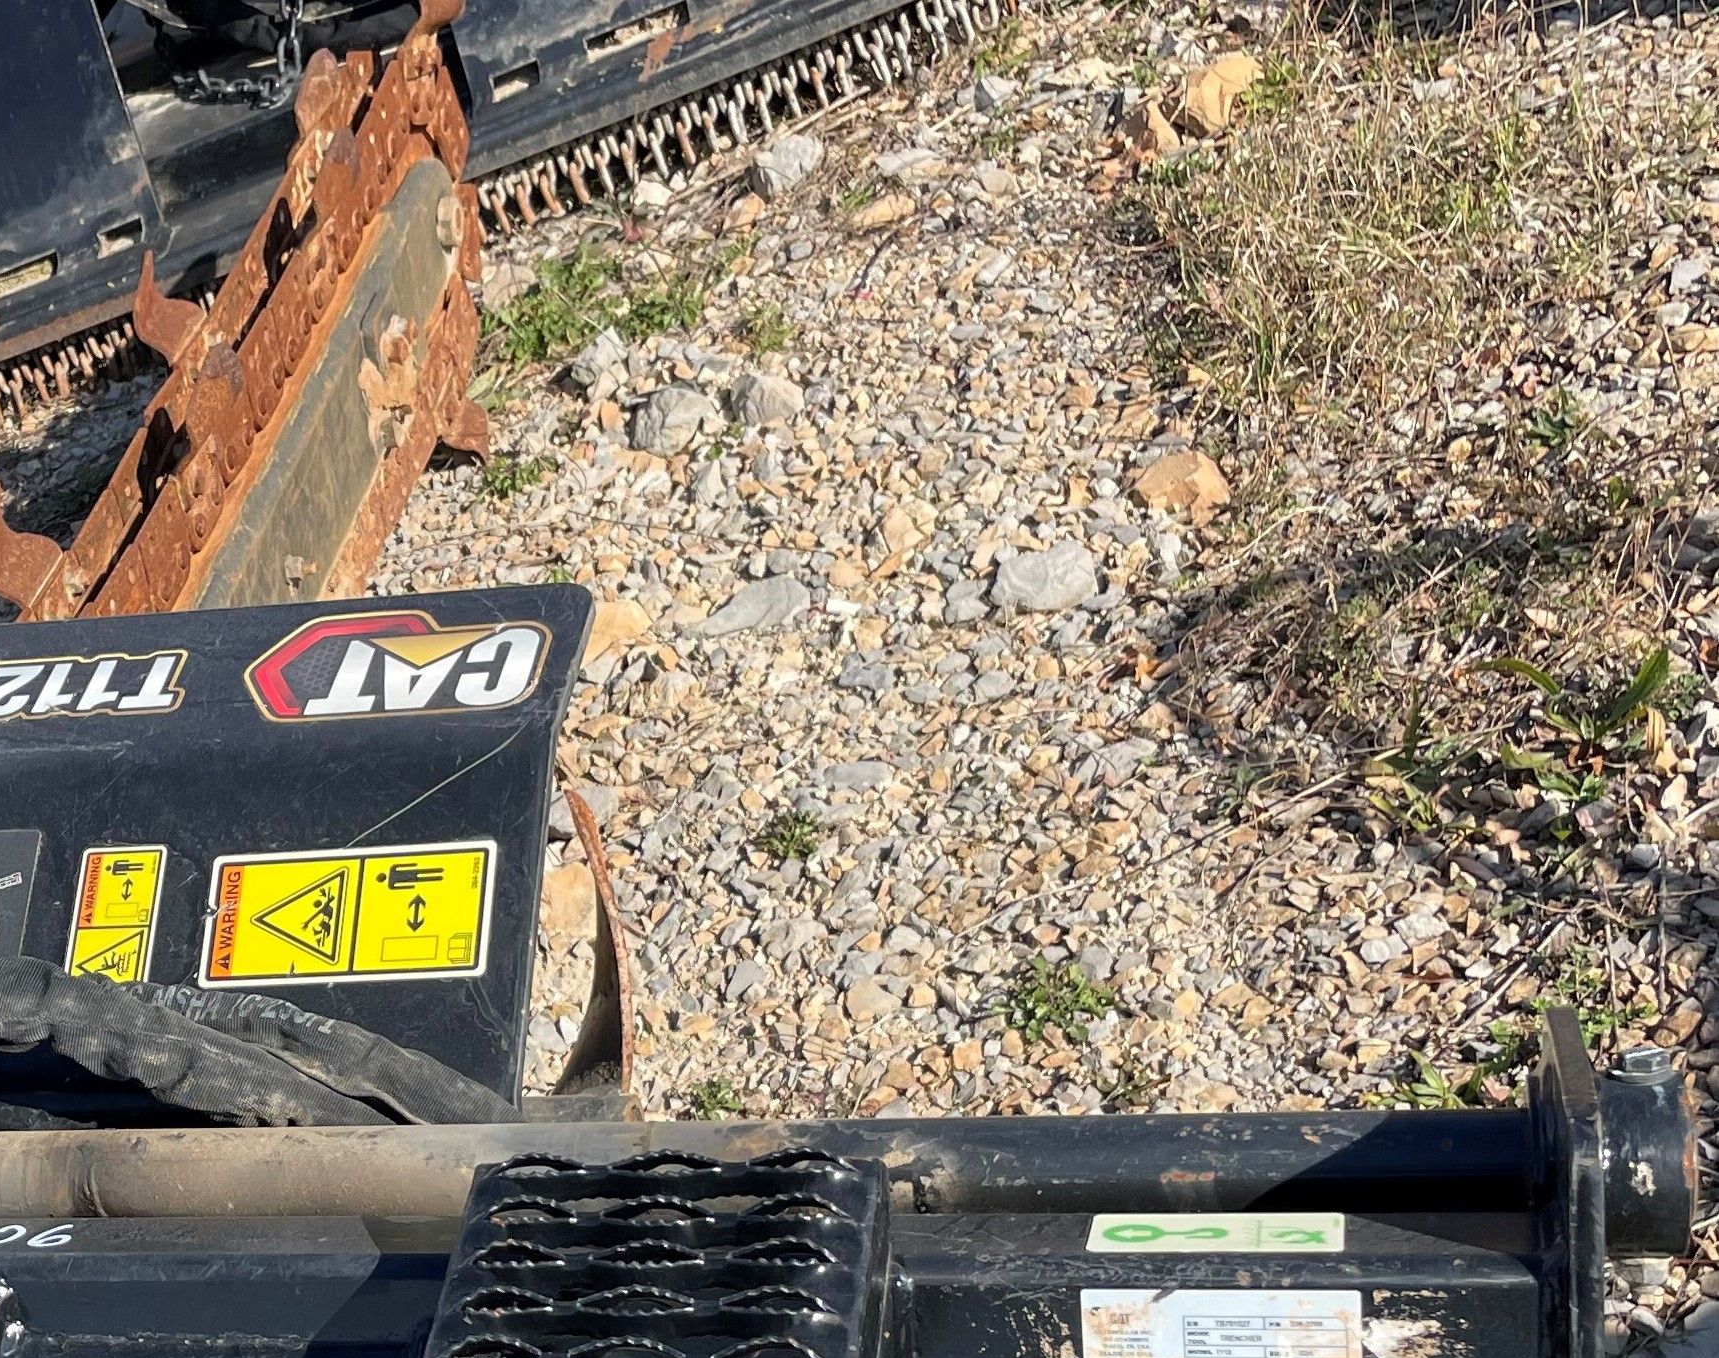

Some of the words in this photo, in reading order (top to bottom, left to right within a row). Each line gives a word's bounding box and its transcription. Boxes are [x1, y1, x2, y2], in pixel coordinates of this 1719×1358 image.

[304, 626, 544, 716] CAT
[84, 856, 102, 911] WARNING
[218, 871, 242, 950] WARNING
